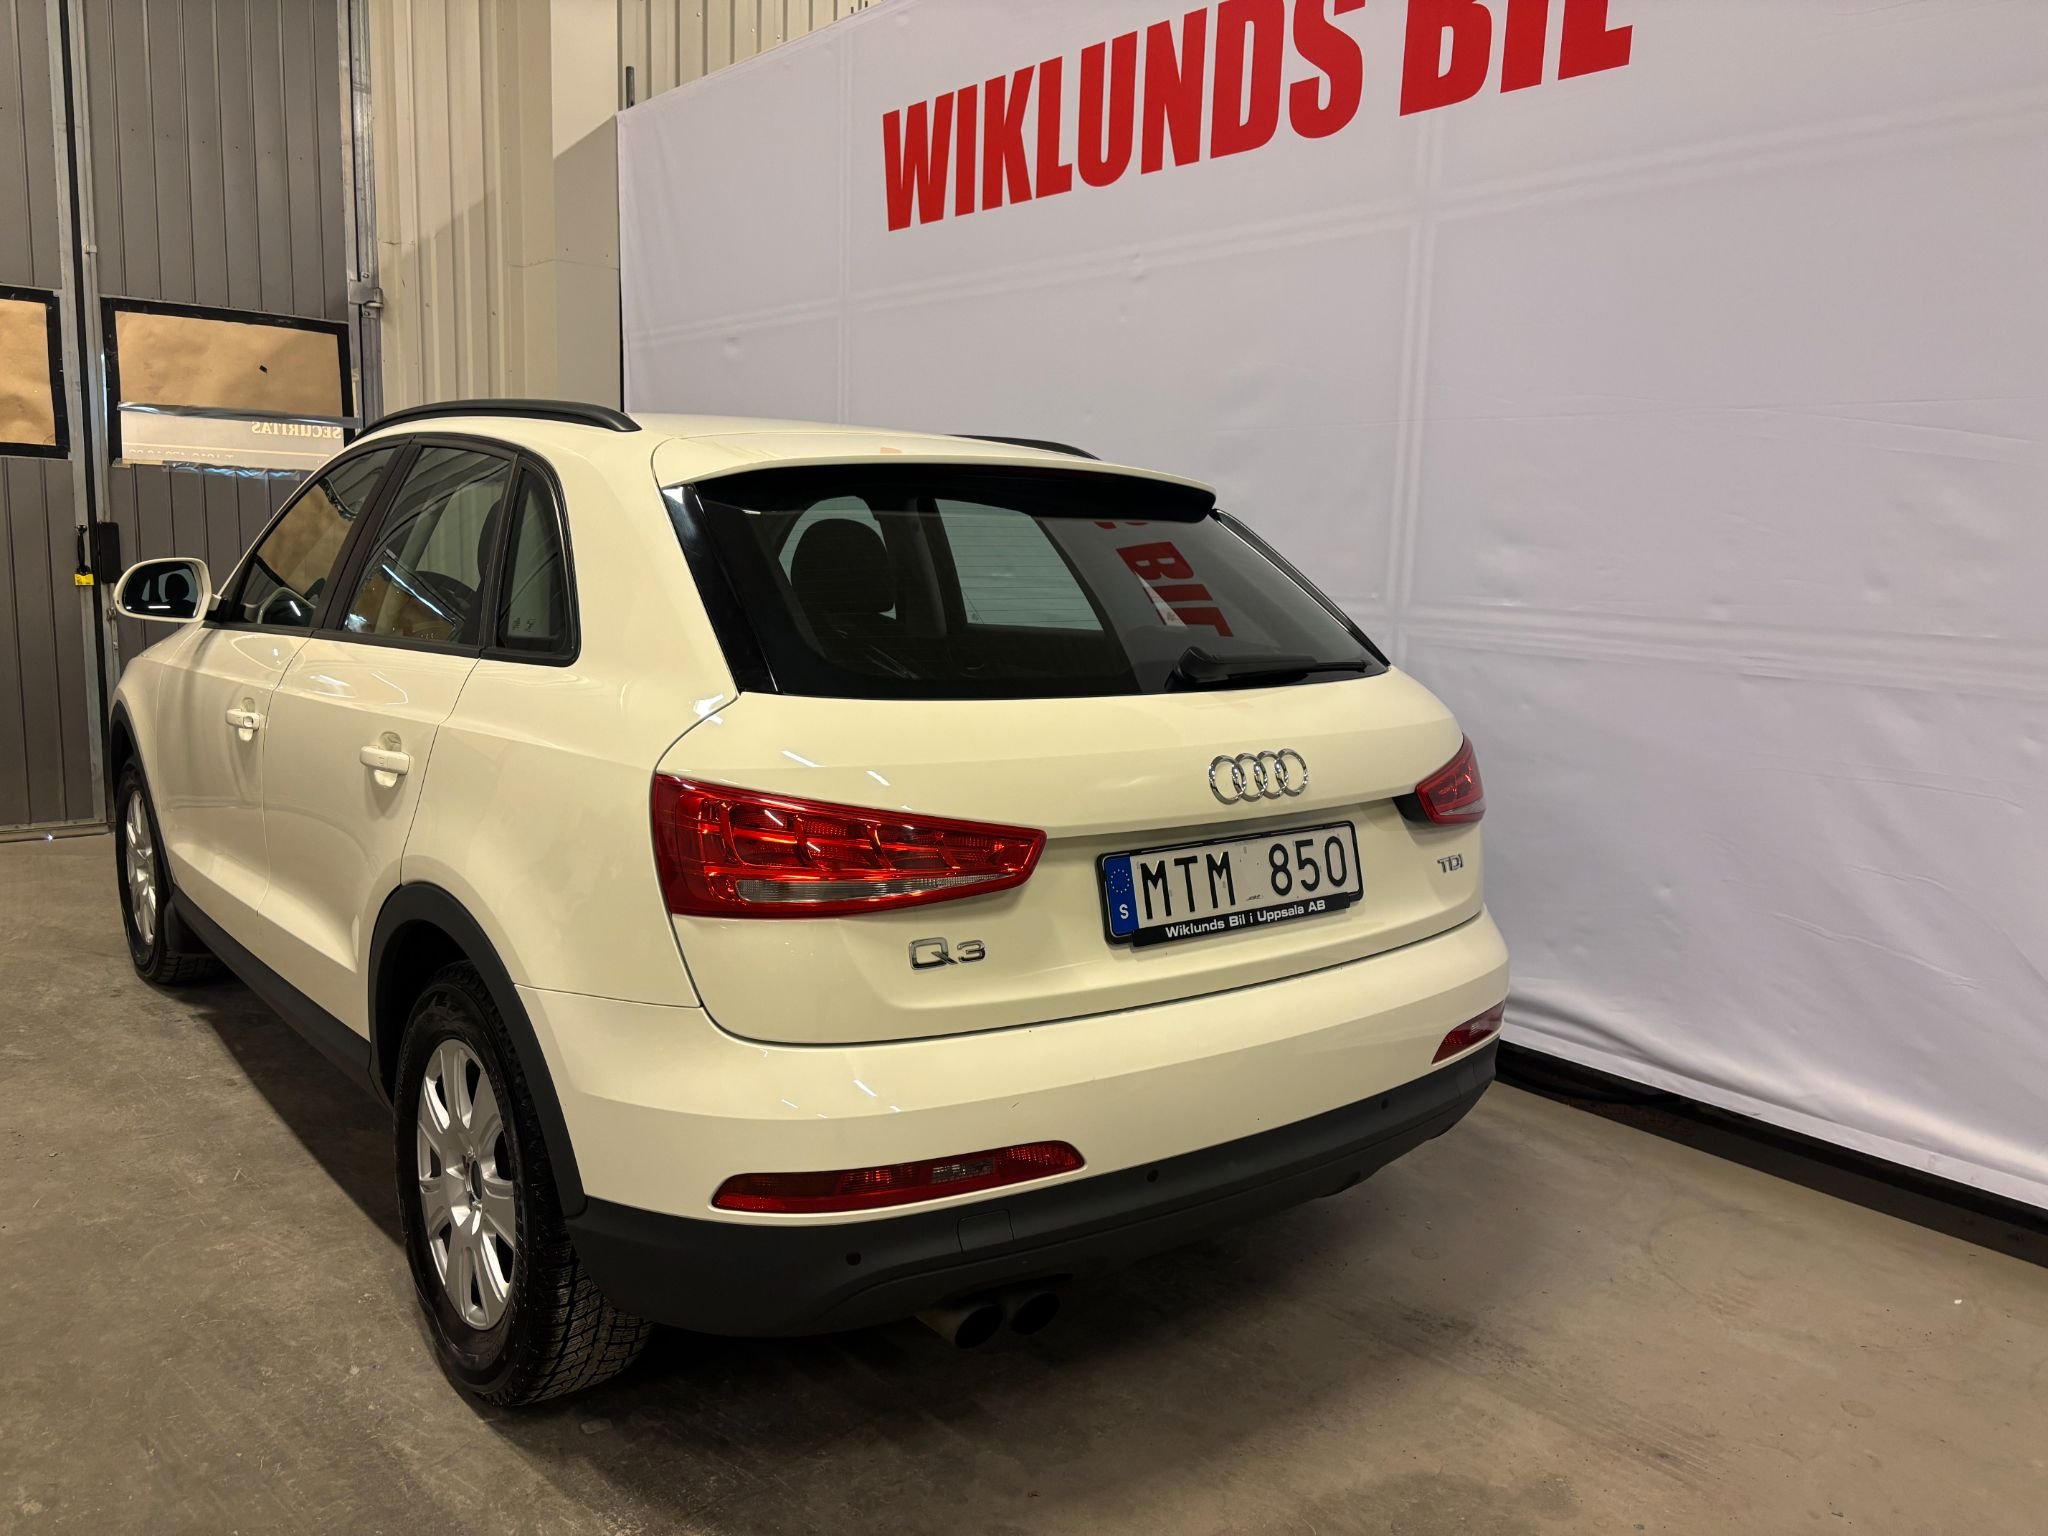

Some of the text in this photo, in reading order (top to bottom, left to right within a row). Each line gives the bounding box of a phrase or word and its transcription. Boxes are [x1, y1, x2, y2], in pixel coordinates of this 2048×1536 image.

[883, 0, 1365, 231] WIKLUNDS
[1140, 835, 1347, 920] MTM 850
[1437, 853, 1463, 873] TDI
[1119, 903, 1129, 920] S
[1165, 919, 1225, 938] Wiklunds
[1229, 914, 1246, 927] Bil
[1257, 904, 1304, 922] Uppsala
[1308, 899, 1326, 912] AB
[909, 936, 986, 970] Q3
